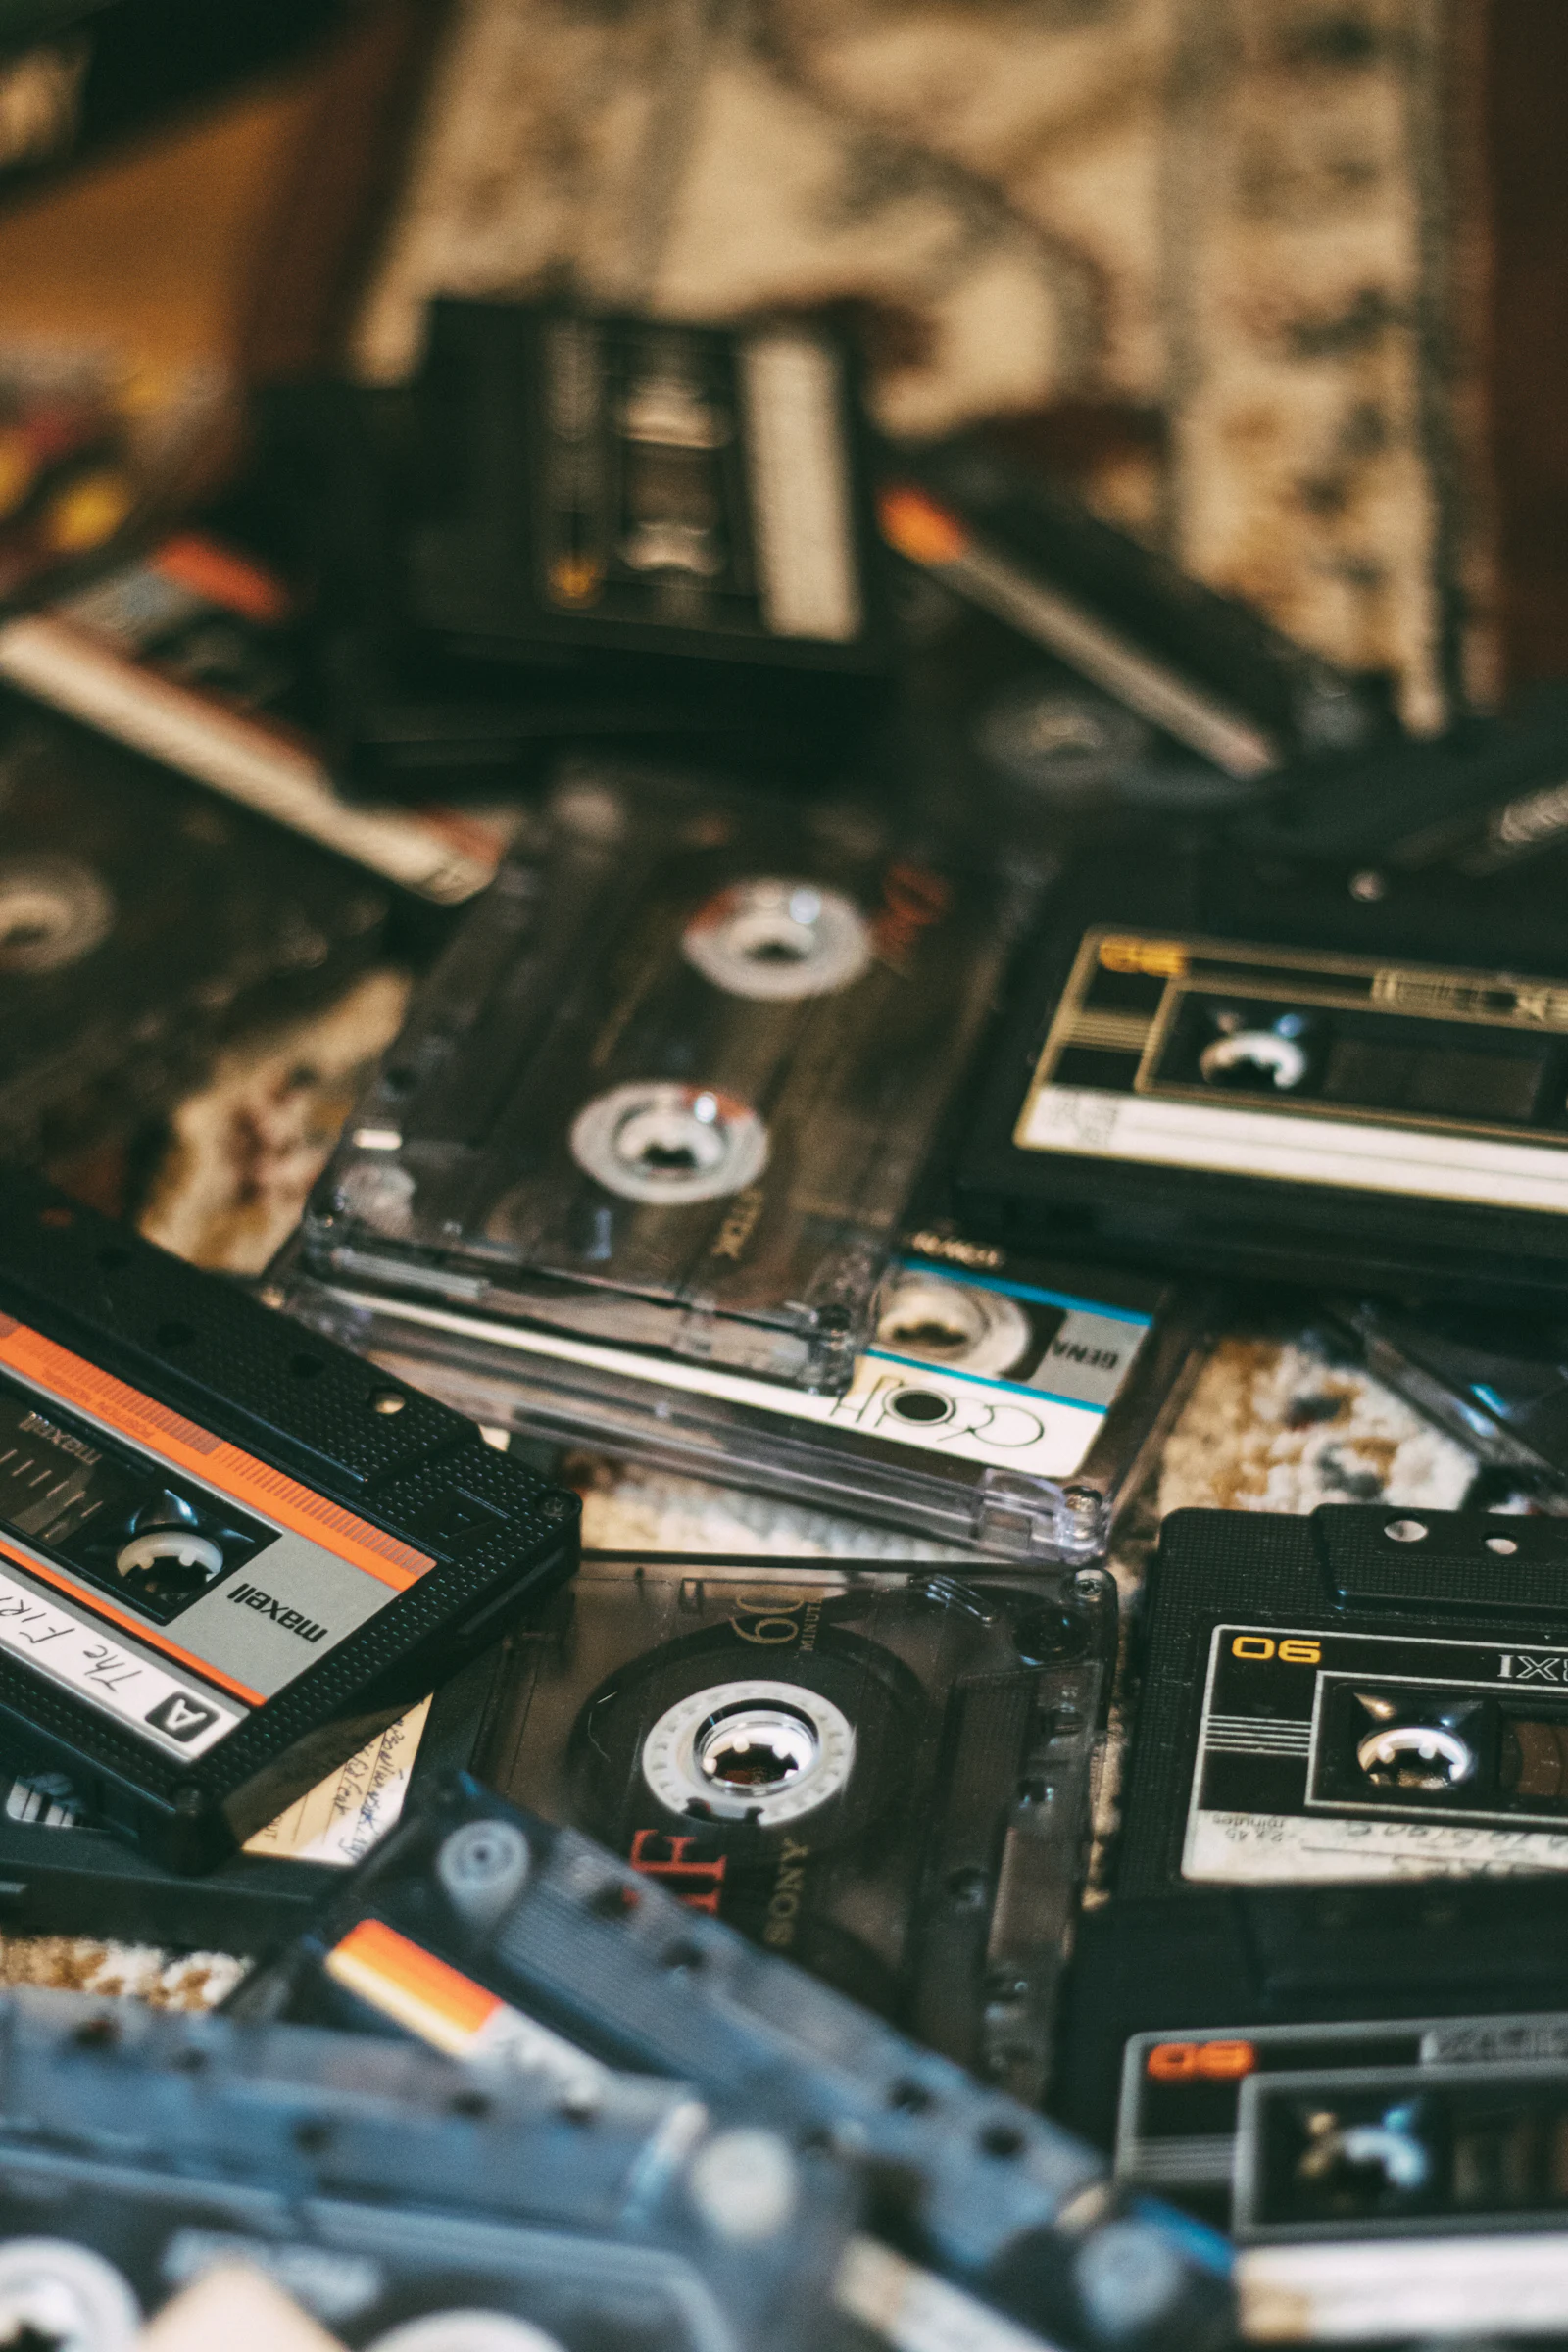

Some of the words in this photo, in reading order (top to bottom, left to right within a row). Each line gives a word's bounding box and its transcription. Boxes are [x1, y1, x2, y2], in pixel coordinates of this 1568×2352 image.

[18, 1409, 102, 1466] maxell
[0, 1596, 75, 1645] FIR
[226, 1583, 328, 1643] maxell
[82, 1642, 143, 1693] The
[1231, 1636, 1322, 1664] 90
[163, 1696, 209, 1731] A
[1211, 1813, 1284, 1831] minutes
[1224, 1827, 1248, 1841] 45
[1271, 1830, 1283, 1842] 2
[761, 1836, 810, 1946] SONY
